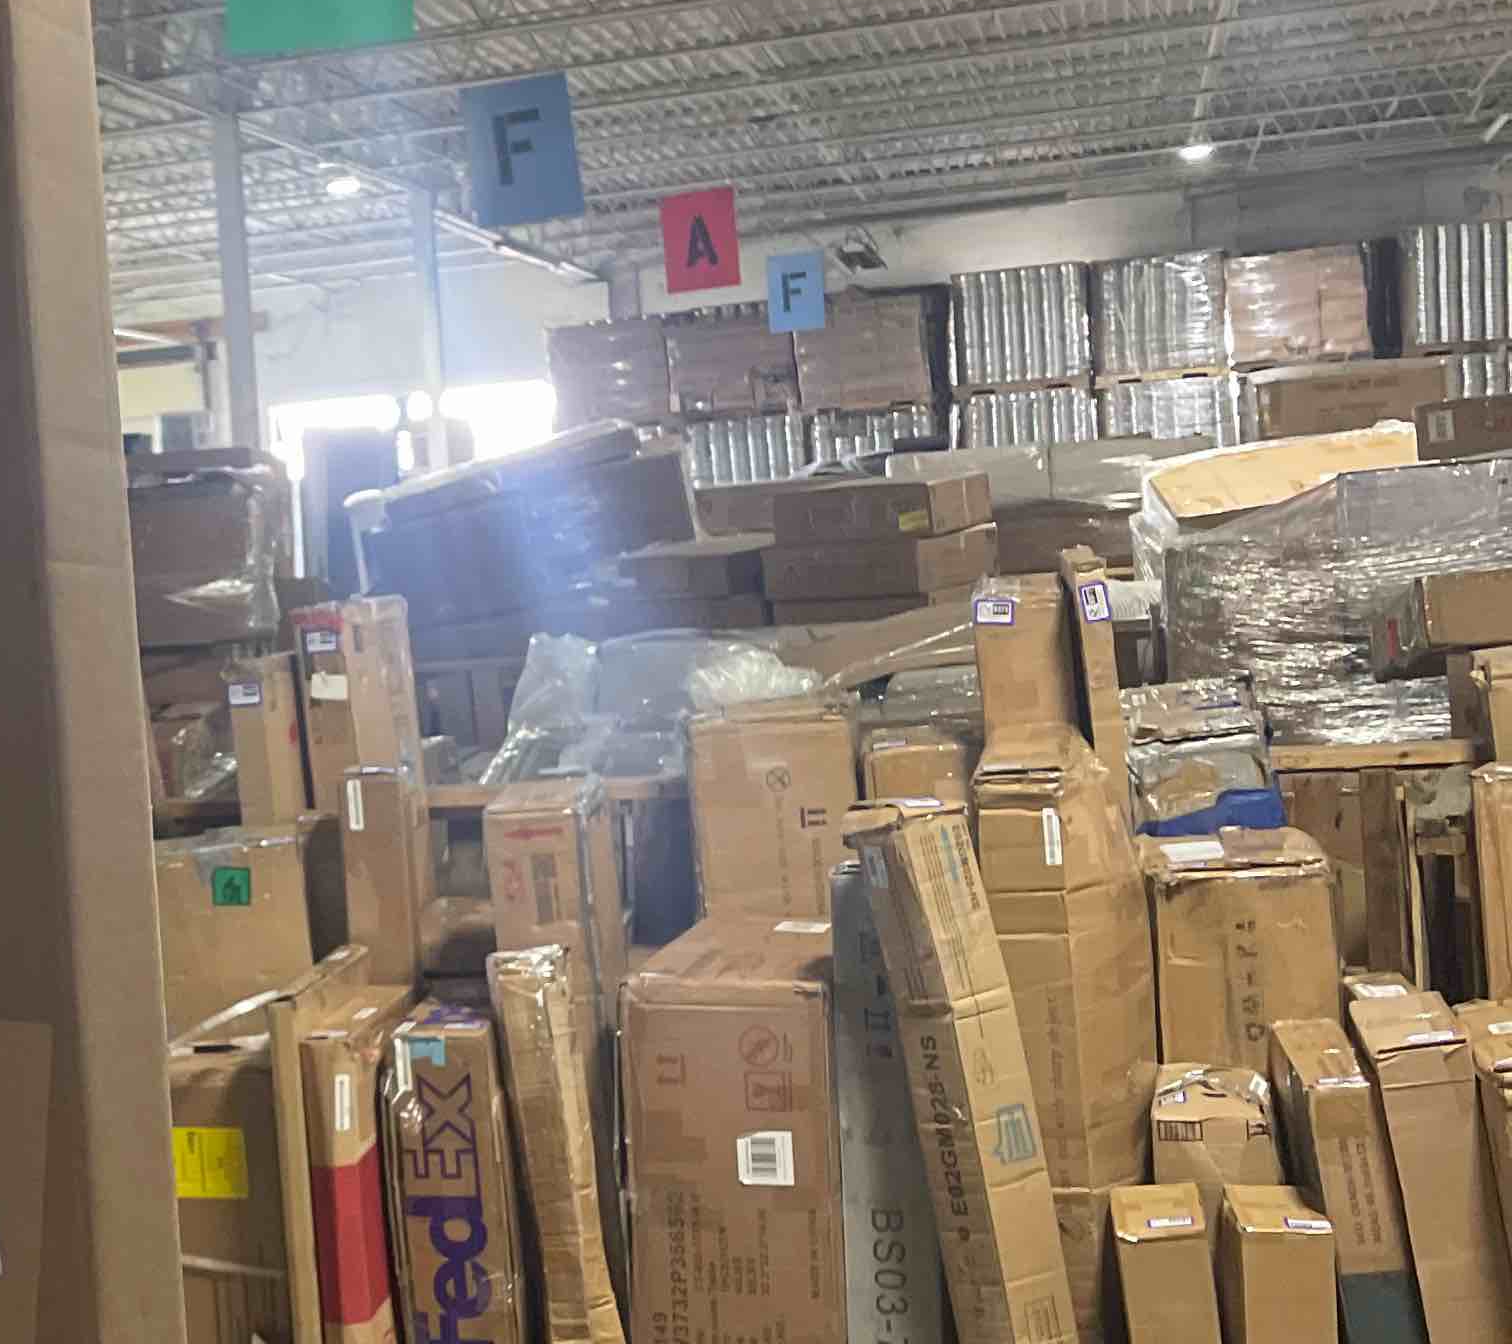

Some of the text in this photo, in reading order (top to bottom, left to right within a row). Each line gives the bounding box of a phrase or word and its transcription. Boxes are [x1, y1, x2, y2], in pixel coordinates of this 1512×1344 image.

[491, 108, 541, 187] F
[685, 214, 717, 270] A
[780, 271, 807, 313] F
